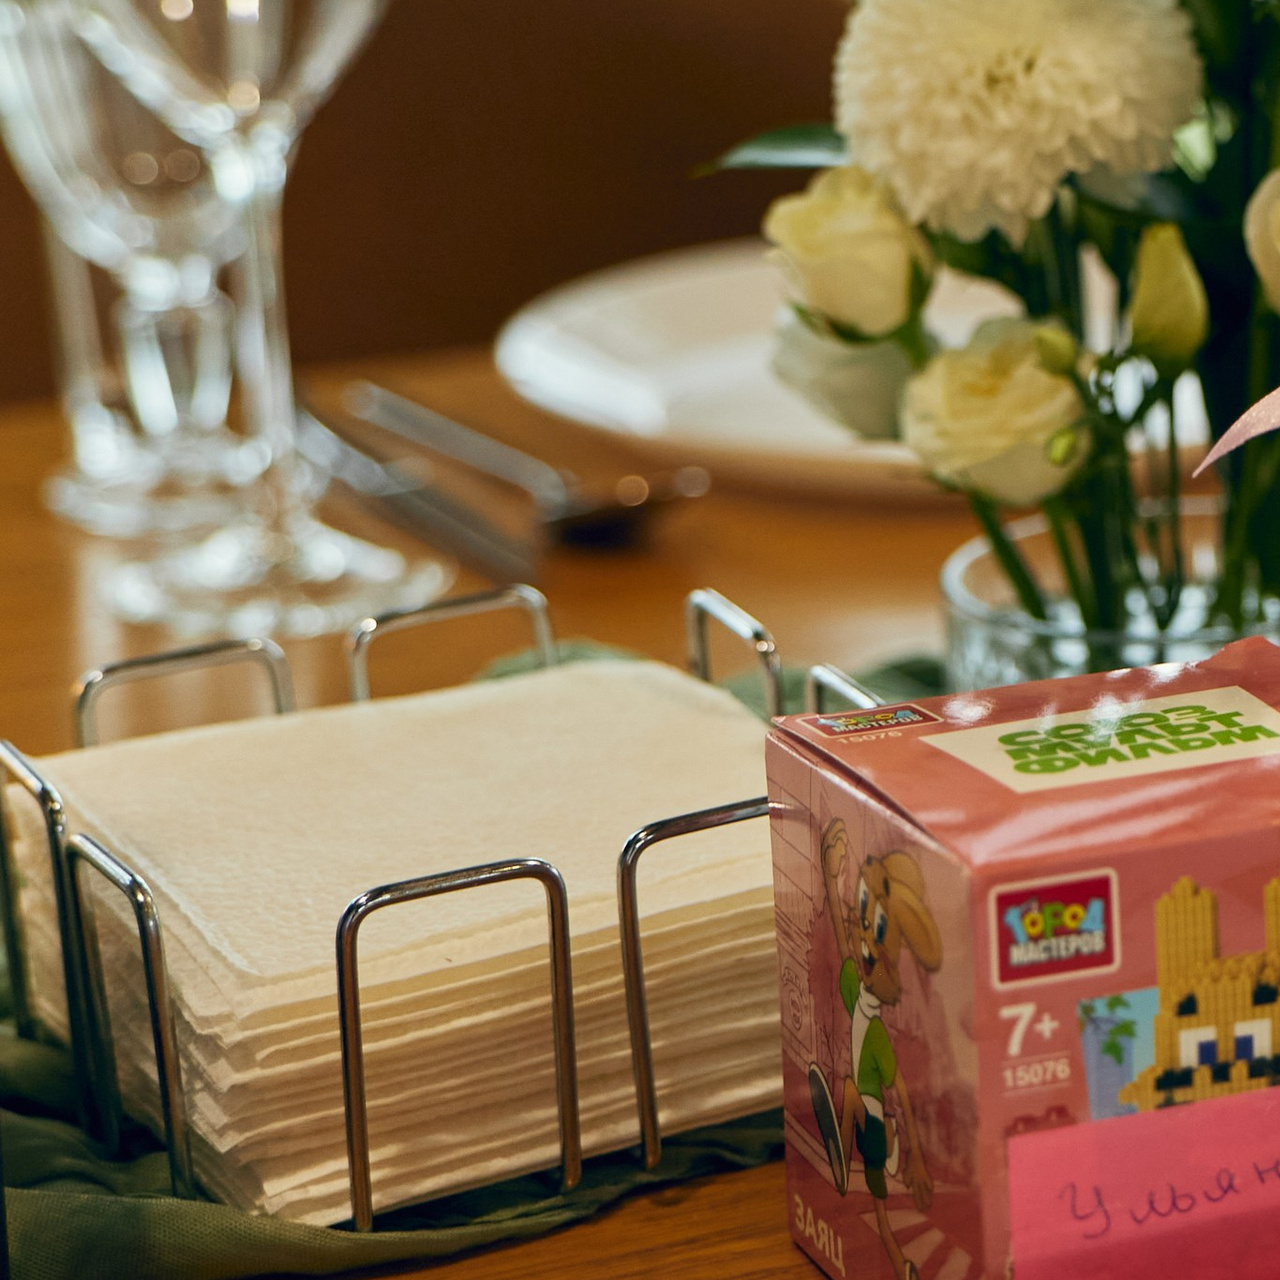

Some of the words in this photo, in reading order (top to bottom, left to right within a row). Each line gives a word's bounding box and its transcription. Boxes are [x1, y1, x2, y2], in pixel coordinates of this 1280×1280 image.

[1009, 930, 1106, 966] МАСТЕРОВ
[999, 1003, 1060, 1056] 7+
[1003, 1058, 1071, 1088] 15076
[794, 1193, 846, 1278] ЗАЯЦ
